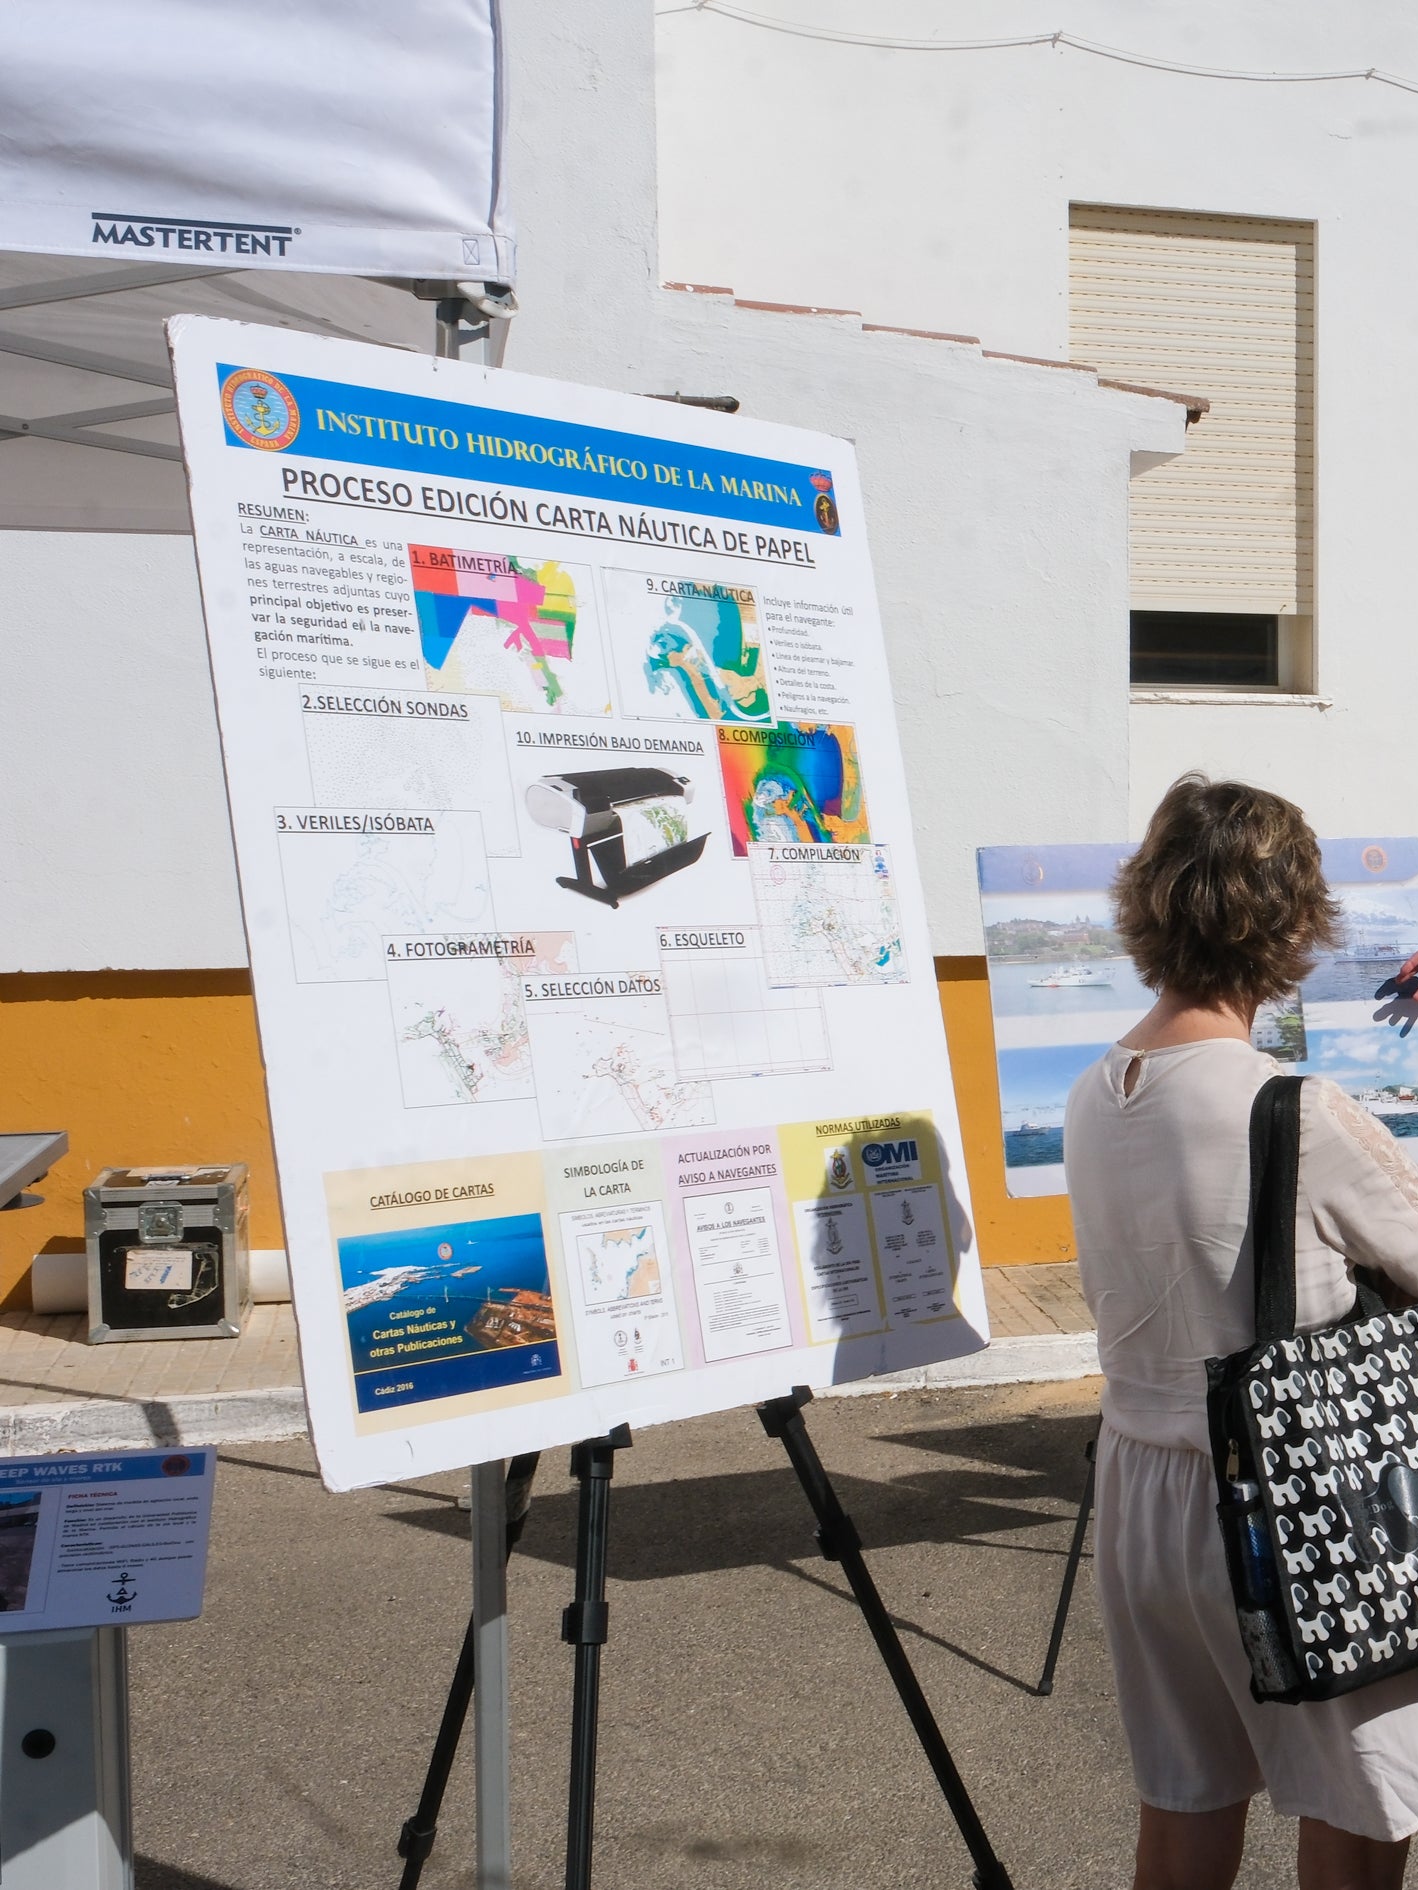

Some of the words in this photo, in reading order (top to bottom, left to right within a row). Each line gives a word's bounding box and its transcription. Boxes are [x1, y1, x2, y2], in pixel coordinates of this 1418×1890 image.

[91, 221, 293, 257] MASTERTENT
[315, 408, 459, 450] INSTITUTO
[465, 432, 648, 480] HIDROGRÁFICO
[653, 463, 683, 486] DE
[687, 469, 715, 492] LA
[719, 475, 802, 507] MARINA
[237, 502, 309, 522] RESUMEN:
[281, 467, 413, 507] PROCESO
[420, 486, 528, 523] EDICIÓN
[535, 502, 613, 535] CARTA
[618, 511, 718, 550] NÁUTICA
[722, 529, 750, 554] DE
[754, 534, 815, 564] PAPEL
[239, 522, 253, 534] La
[259, 524, 299, 541] CARTA
[305, 528, 359, 548] NÁUTICA
[364, 538, 377, 549] es
[382, 541, 403, 551] una
[242, 542, 333, 562] representación,
[337, 552, 345, 561] a
[349, 553, 387, 567] escala,
[391, 555, 406, 568] de
[412, 551, 425, 565] 1.
[429, 552, 518, 574] BATIMETRÍA
[244, 556, 262, 570] las
[264, 561, 298, 575] aguas
[301, 565, 364, 580] navegables
[366, 572, 373, 583] y
[376, 572, 408, 587] regio-
[247, 577, 268, 588] nes
[271, 578, 329, 594] terrestres
[332, 583, 381, 599] adjuntas
[384, 591, 410, 603] cuyo
[646, 578, 659, 592] 9.
[660, 579, 700, 598] CARTA
[703, 582, 756, 604] NÁUTICA
[249, 593, 302, 610] principal
[305, 598, 353, 613] objetivo
[356, 605, 370, 614] es
[372, 606, 413, 618] preser-
[763, 596, 792, 609] Incluye
[793, 599, 840, 615] información
[251, 612, 271, 623] var
[274, 612, 286, 624] la
[290, 616, 348, 629] seguridad
[369, 620, 380, 632] la
[384, 624, 415, 635] nave-
[765, 611, 784, 622] para
[784, 613, 793, 623] el
[254, 629, 293, 643] gación
[296, 632, 353, 647] marítima.
[256, 647, 267, 659] El
[271, 650, 318, 663] proceso
[320, 654, 343, 667] que
[346, 656, 359, 666] se
[361, 655, 391, 671] sigue
[394, 659, 407, 669] es
[409, 658, 420, 670] el
[258, 665, 317, 681] siguiente:
[301, 695, 402, 715] 2.SELECCIÓN
[406, 701, 469, 718] SONDAS
[516, 730, 536, 745] 10.
[538, 732, 608, 749] IMPRESIÓN
[611, 736, 641, 752] BAJO
[643, 738, 705, 754] DEMANDA
[718, 728, 730, 741] 8.
[732, 729, 816, 746] COMPOSICIÓN
[276, 814, 292, 830] 3.
[296, 813, 435, 833] VERILES/ISÓBATA
[769, 848, 780, 861] 7.
[782, 846, 861, 861] COMPILACIÓN
[386, 943, 401, 958] 4.
[405, 937, 536, 957] FOTOGRAMETRÍA
[659, 933, 672, 947] 6.
[675, 932, 745, 949] ESQUELETO
[524, 983, 538, 998] 5.
[541, 977, 615, 998] SELECCIÓN
[618, 978, 662, 994] DATOS
[815, 1123, 854, 1135] NORMAS
[855, 1117, 901, 1131] UTILIZADAS
[677, 1144, 750, 1164] ACTUALIZACIÓN
[752, 1143, 772, 1156] POR
[861, 1140, 919, 1168] OMI
[563, 1159, 629, 1179] SIMBOLOGÍA
[631, 1159, 644, 1172] DE
[677, 1171, 707, 1185] AVISO
[708, 1170, 716, 1182] A
[717, 1163, 777, 1181] NAVEGANTES
[370, 1189, 432, 1208] CATÁLOGO
[434, 1187, 450, 1202] DE
[451, 1183, 495, 1200] CARTAS
[583, 1186, 597, 1198] LA
[598, 1182, 632, 1197] CARTA
[389, 1306, 424, 1321] Catálogo
[425, 1306, 437, 1316] de
[372, 1328, 405, 1340] Cartas
[406, 1320, 448, 1335] Náuticas
[449, 1320, 456, 1331] y
[370, 1347, 395, 1358] otras
[397, 1334, 463, 1354] Publicaciones
[374, 1384, 396, 1396] Cádiz
[396, 1382, 414, 1392] 2016
[33, 1464, 89, 1477] WAVES
[92, 1462, 123, 1473] RTK
[111, 1604, 132, 1613] IHM
